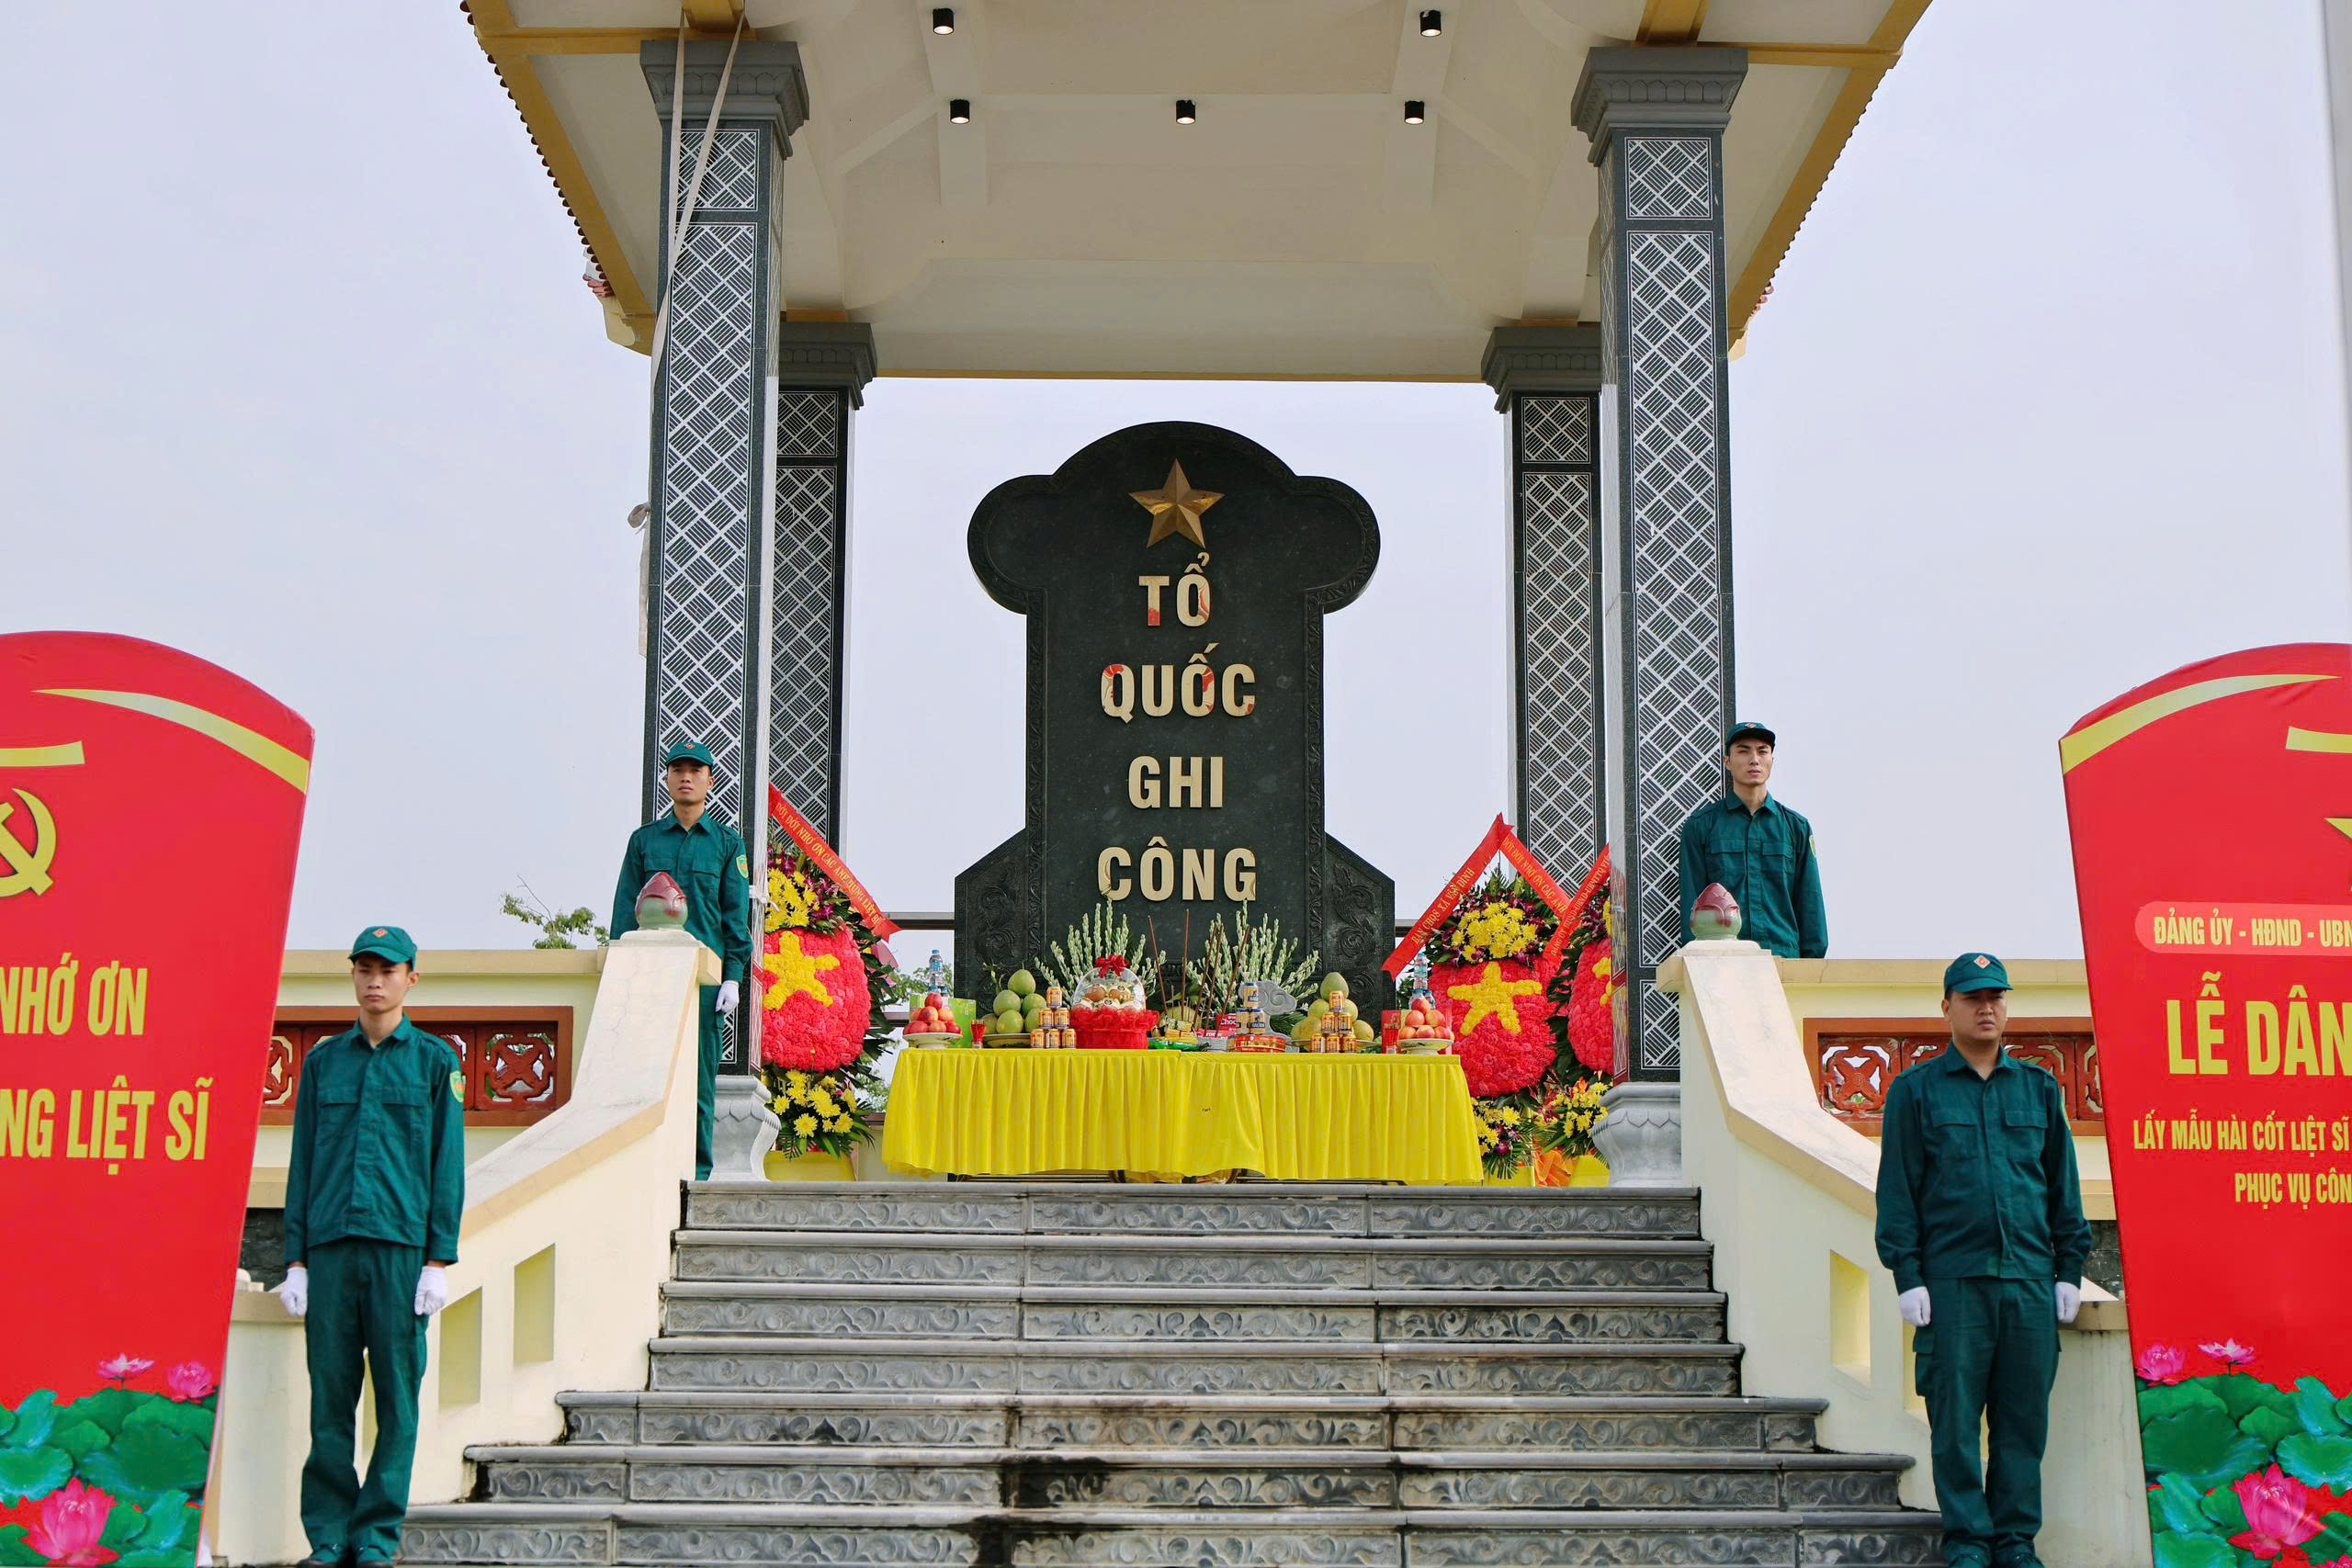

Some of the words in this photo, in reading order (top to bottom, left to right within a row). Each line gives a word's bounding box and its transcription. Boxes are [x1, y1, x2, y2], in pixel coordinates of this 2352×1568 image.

[1138, 551, 1211, 627] TỔ
[1100, 642, 1257, 724] QUỐC
[1127, 755, 1224, 809] GHI
[1097, 836, 1257, 901] CÔNG
[2154, 907, 2205, 944] ĐẢNG
[2210, 908, 2233, 945] ỦY
[2252, 919, 2301, 947] HĐND
[0, 952, 79, 1035] NHỚ
[87, 960, 148, 1036] ƠN
[2166, 971, 2228, 1075] LỄ
[2245, 985, 2352, 1076] DÂN
[0, 1089, 55, 1158] NG
[66, 1075, 155, 1175] LIỆT
[164, 1077, 213, 1161] SĨ
[2132, 1109, 2165, 1149] LẤY
[2171, 1109, 2211, 1150] MẪU
[2217, 1113, 2247, 1150] HÀI
[2252, 1110, 2286, 1151] CỐT
[2290, 1114, 2326, 1157] LIỆT
[2332, 1116, 2350, 1151] SĨ
[2234, 1173, 2283, 1210] PHỤC
[2287, 1173, 2311, 1210] VỤ
